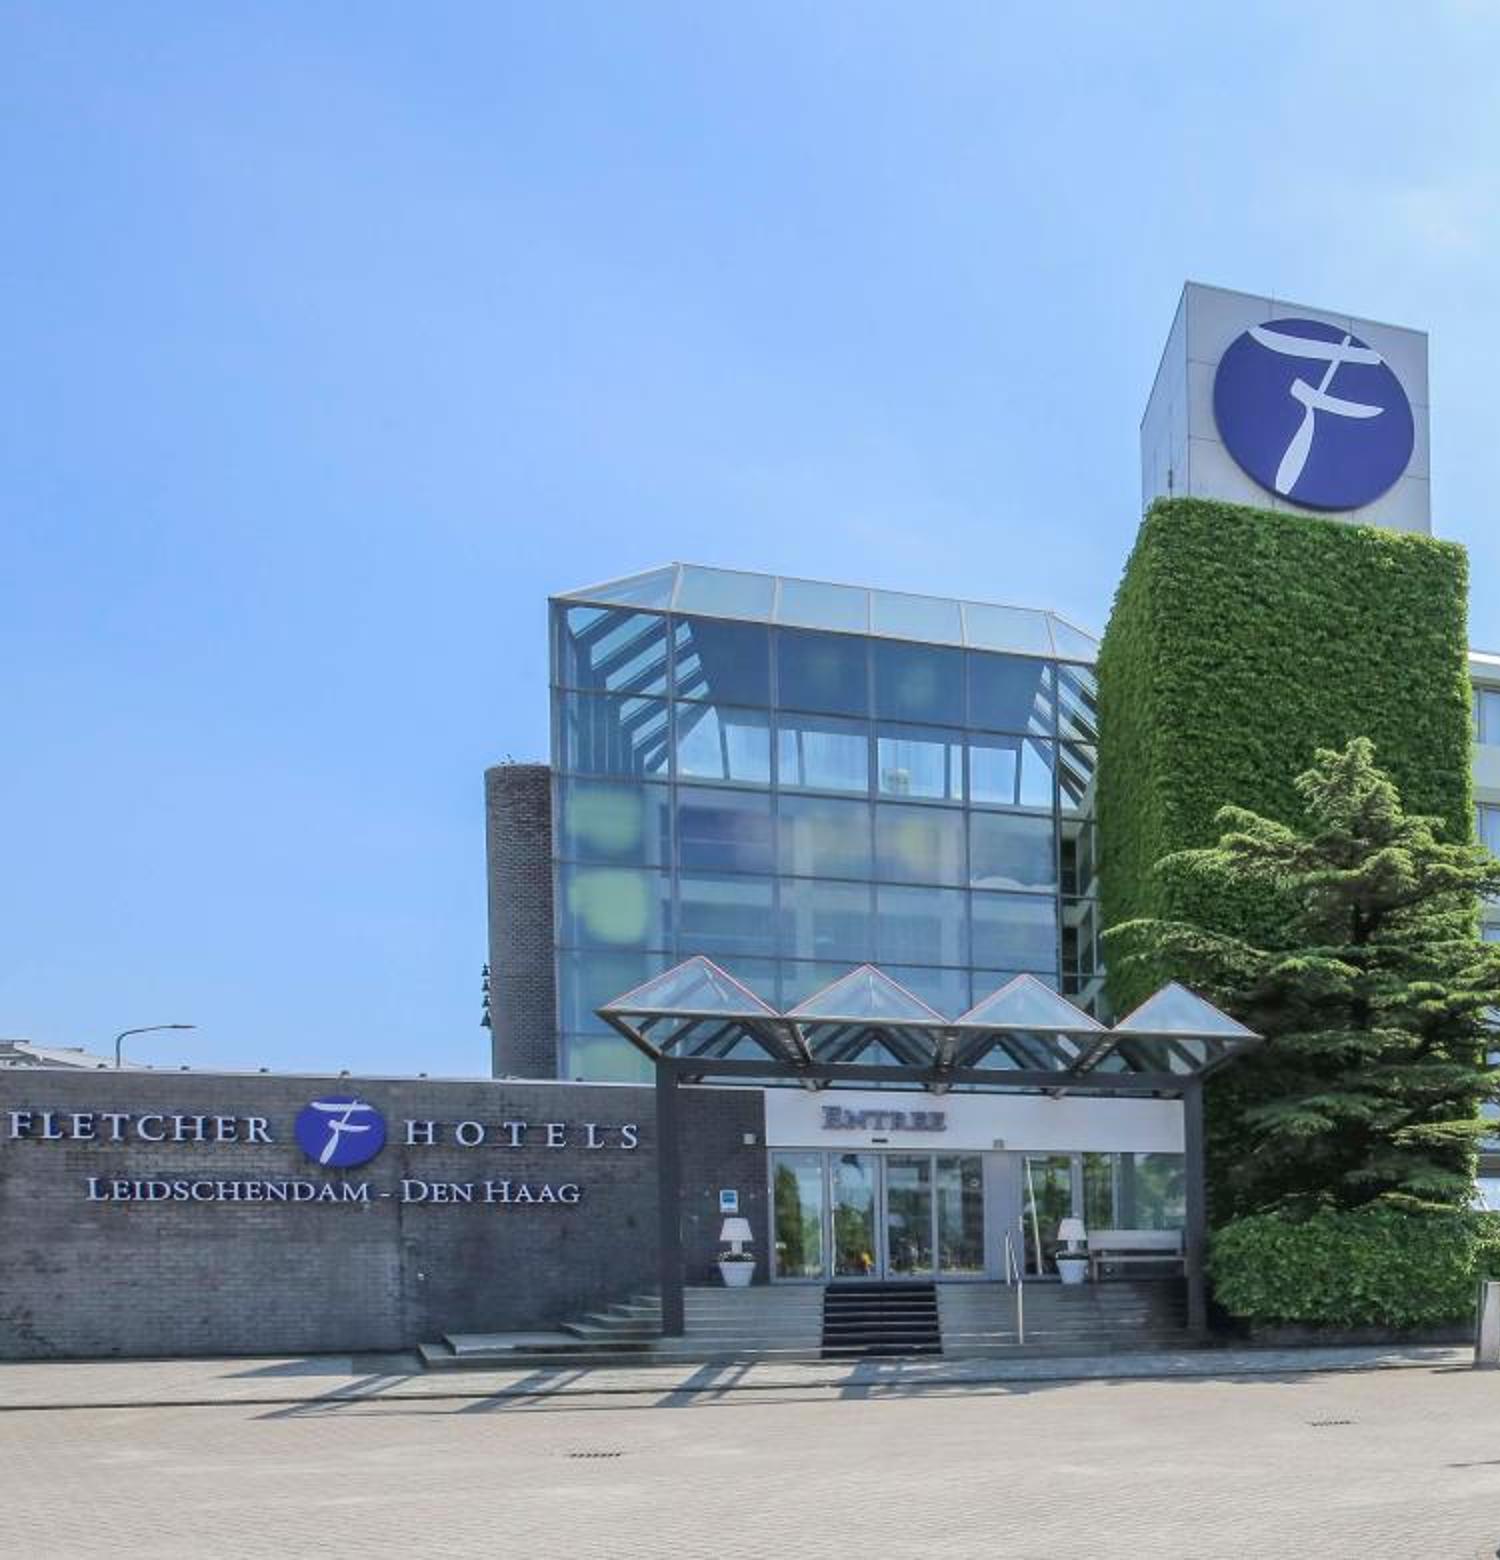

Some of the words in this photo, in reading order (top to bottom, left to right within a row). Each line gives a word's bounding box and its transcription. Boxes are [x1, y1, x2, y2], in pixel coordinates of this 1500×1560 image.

[8, 1111, 273, 1143] FLETCHER
[404, 1120, 638, 1149] HOTELS
[86, 1177, 368, 1201] LEIDSCHENDAM
[402, 1179, 473, 1203] DEN
[484, 1181, 580, 1204] HAAG
